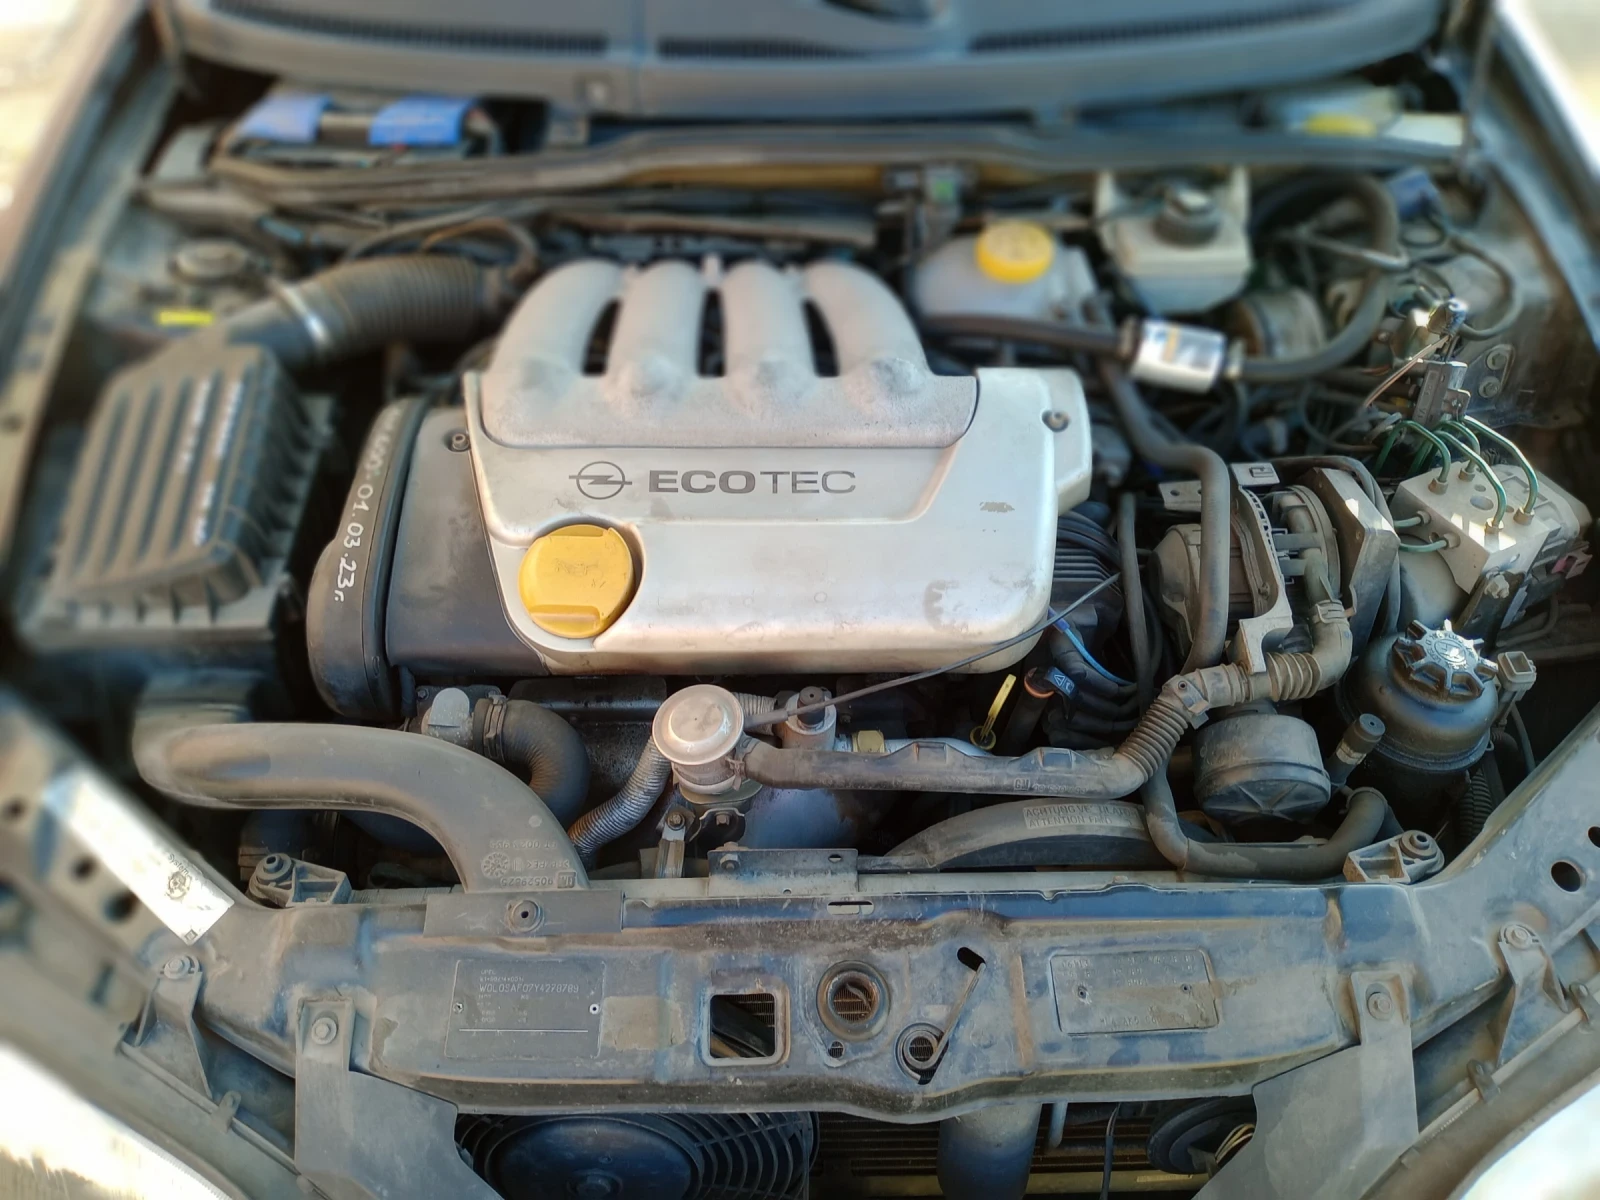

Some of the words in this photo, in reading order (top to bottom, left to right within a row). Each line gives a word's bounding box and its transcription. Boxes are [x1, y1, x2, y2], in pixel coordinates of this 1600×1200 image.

[649, 470, 856, 494] ECOTEC
[1026, 805, 1076, 817] ACHTUNG
[1030, 816, 1085, 828] ATTENTION
